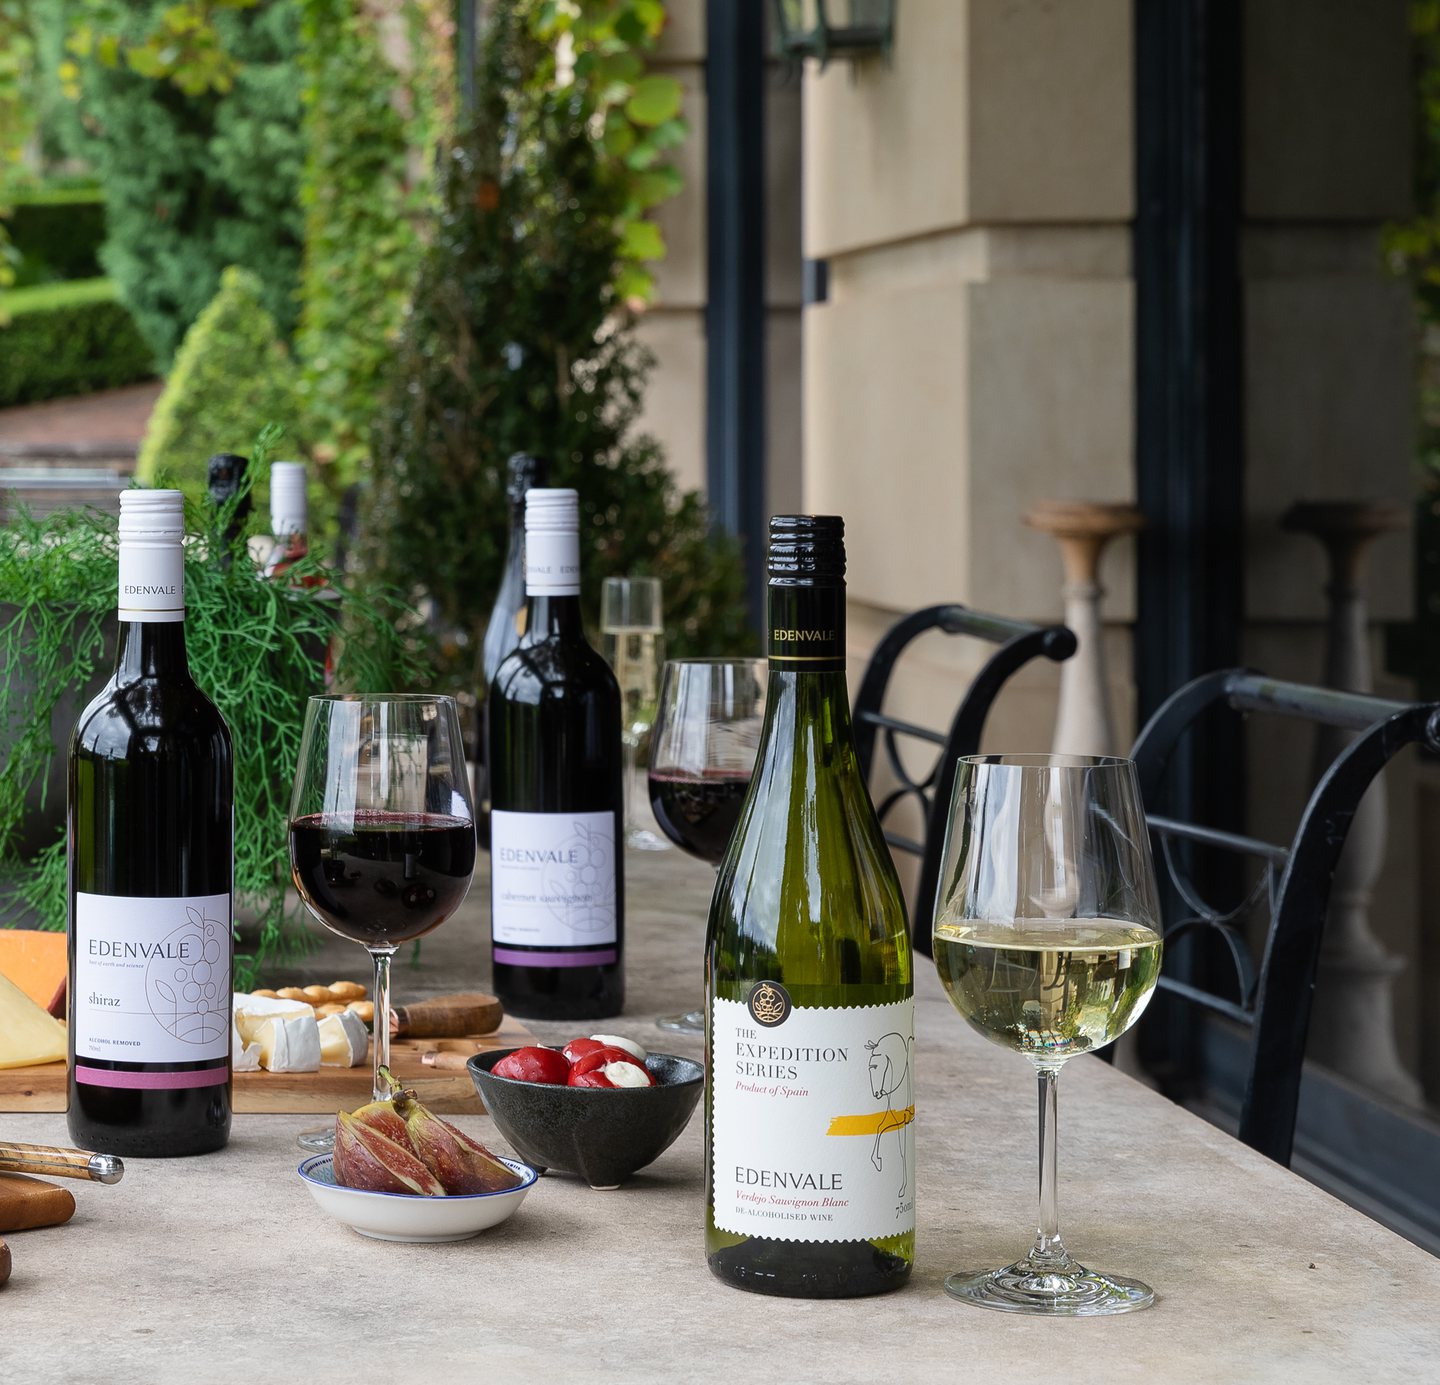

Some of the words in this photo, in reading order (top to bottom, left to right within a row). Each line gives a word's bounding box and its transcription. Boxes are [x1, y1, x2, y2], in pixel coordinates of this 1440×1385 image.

[124, 585, 176, 595] EDENVALE
[774, 629, 835, 641] EDENVALE
[500, 847, 578, 864] EDENVALE
[89, 939, 190, 959] EDENVALE
[88, 992, 121, 1007] shiraz
[735, 1027, 758, 1040] THE
[736, 1042, 849, 1062] EXPEDITION
[735, 1060, 798, 1080] SERIES
[735, 1081, 766, 1094] Product
[768, 1085, 780, 1097] of
[780, 1086, 809, 1099] Spain
[735, 1166, 843, 1191] EDENVALE
[736, 1190, 767, 1205] Verdejo
[768, 1195, 819, 1210] Sauvignon
[821, 1197, 849, 1207] Blanc
[735, 1206, 807, 1221] DE-ALCOHOLISED
[809, 1214, 834, 1222] WINE
